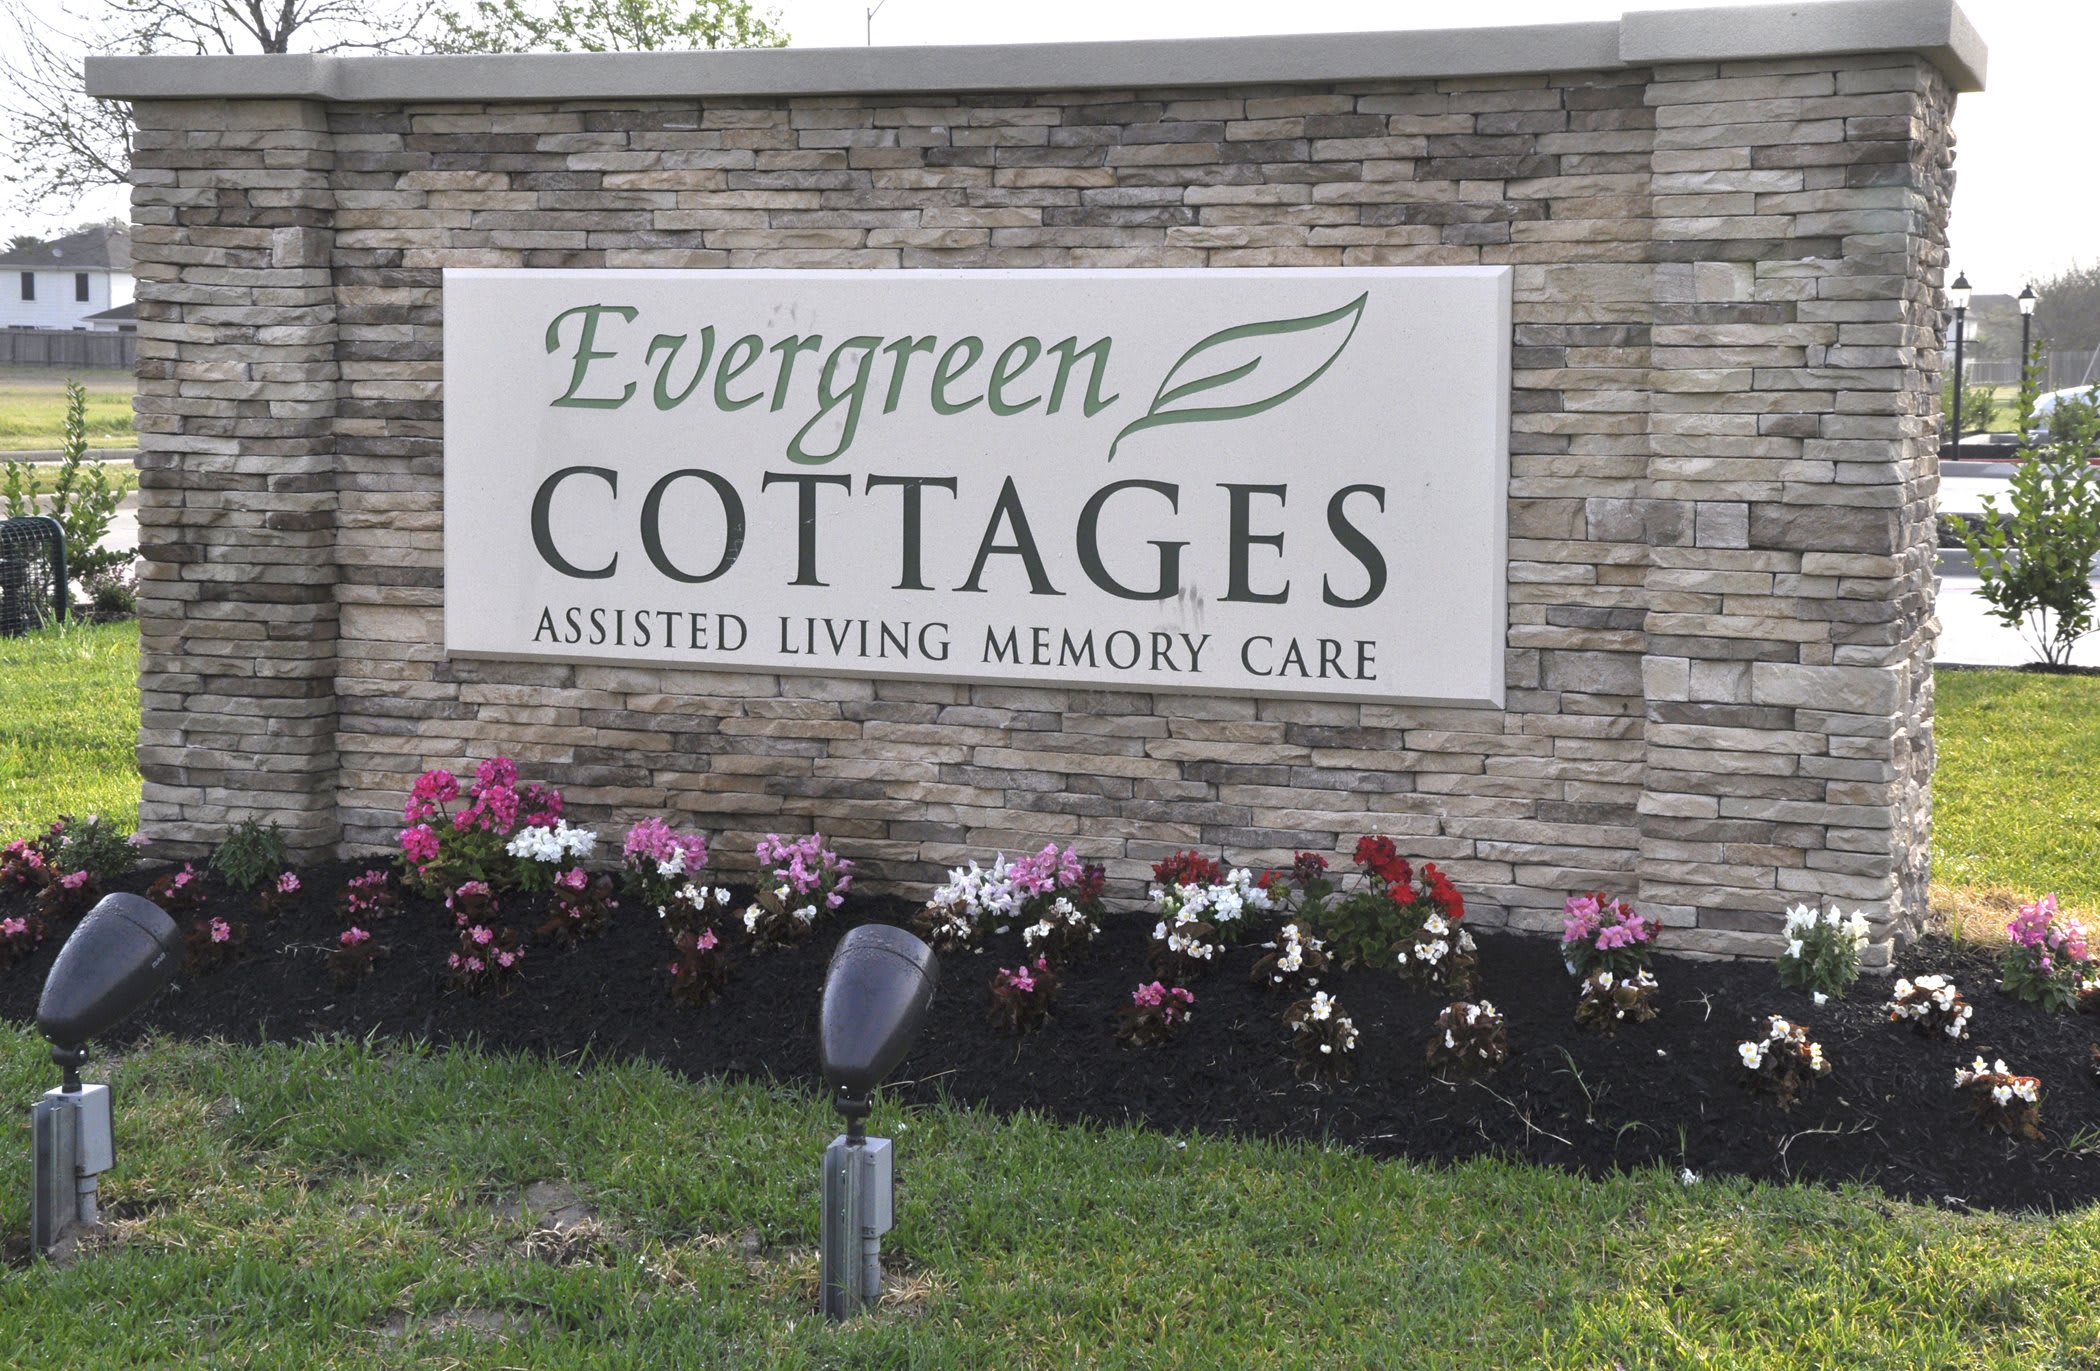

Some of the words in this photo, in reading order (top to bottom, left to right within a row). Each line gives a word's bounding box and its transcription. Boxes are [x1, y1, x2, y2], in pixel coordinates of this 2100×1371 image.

[545, 303, 1119, 466] Evergreen
[530, 465, 1388, 609] COTTAGES
[532, 605, 748, 652] ASSISTED
[778, 616, 950, 661] LIVING
[981, 624, 1212, 673] MEMORY
[1240, 635, 1378, 681] CARE
